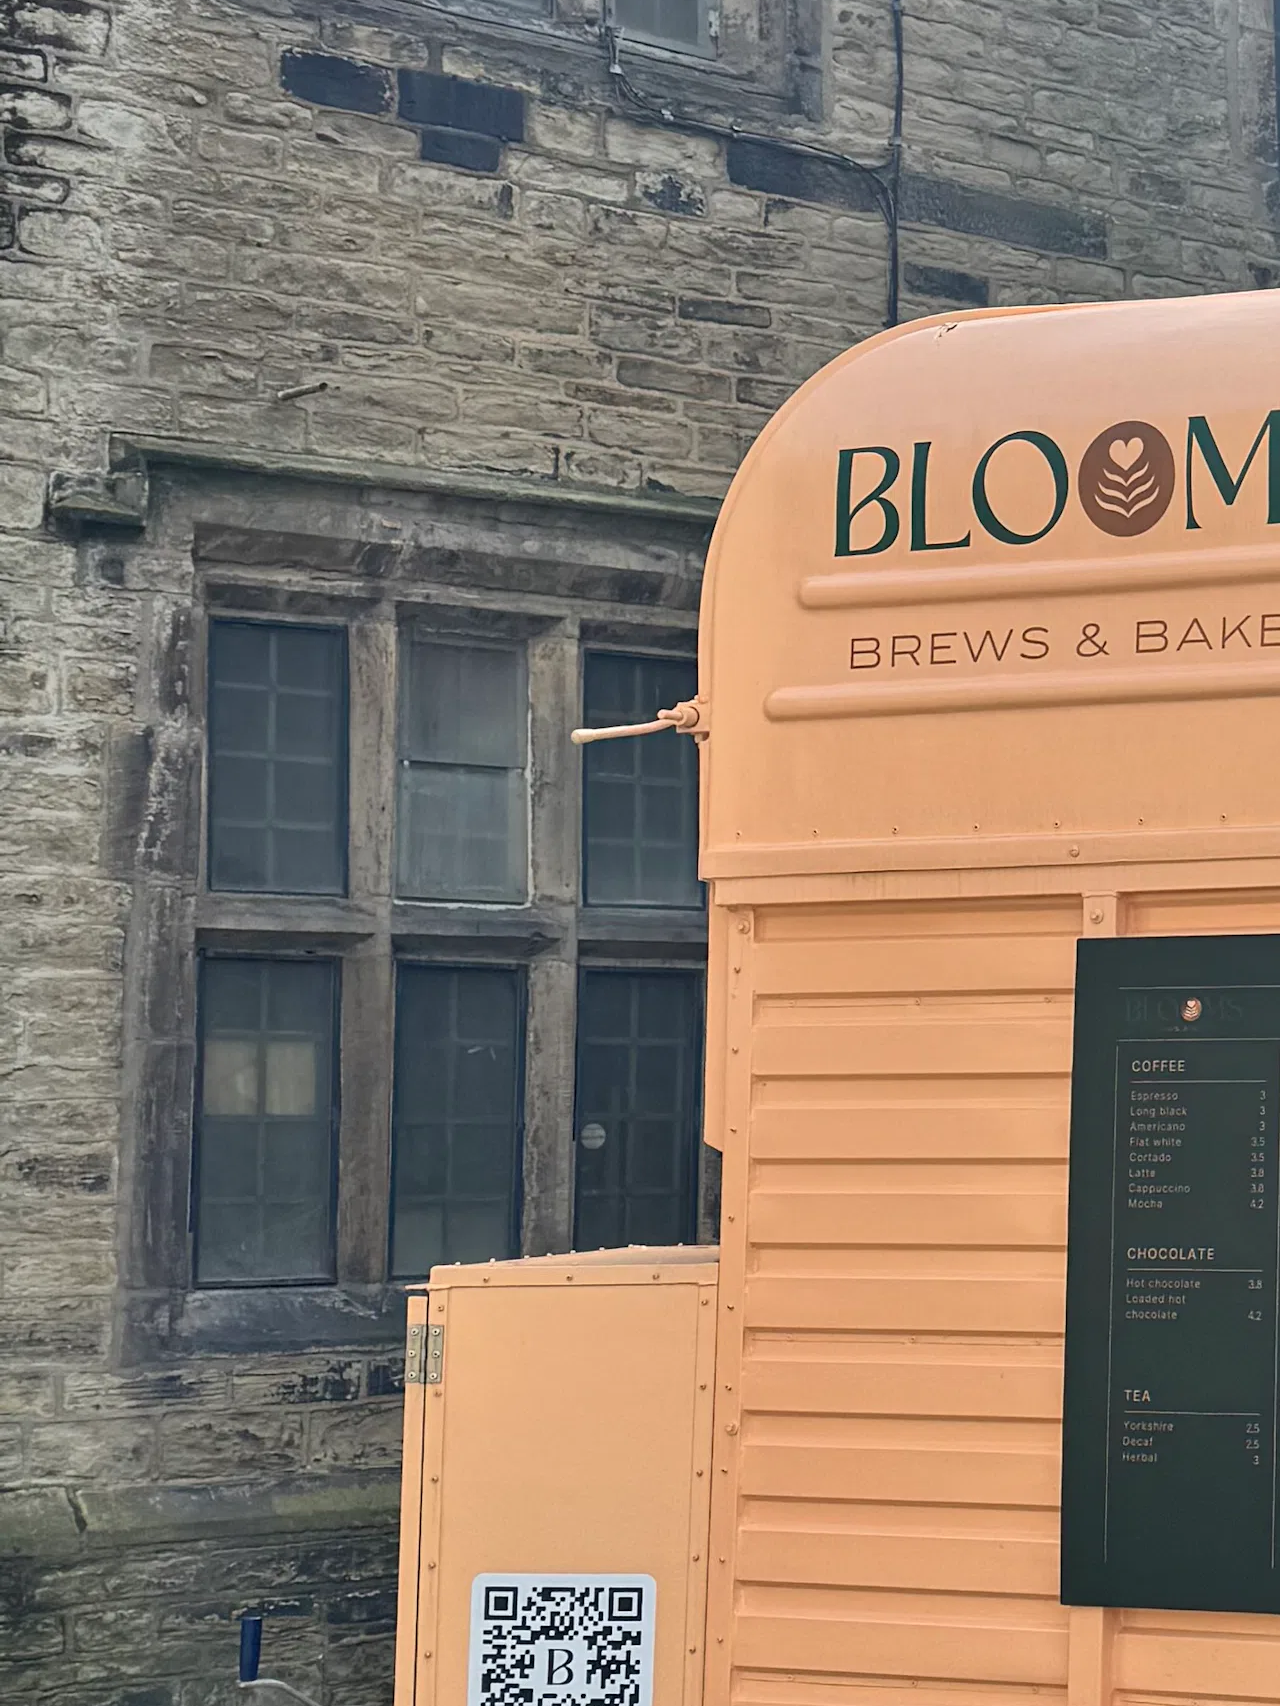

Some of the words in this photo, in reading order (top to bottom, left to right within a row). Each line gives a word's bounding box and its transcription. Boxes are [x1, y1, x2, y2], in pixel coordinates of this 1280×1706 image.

[850, 627, 1050, 670] BREWS
[1076, 623, 1110, 656] &
[1132, 1060, 1185, 1072] COFFEE
[1131, 1091, 1178, 1101] Espresso
[1260, 1090, 1265, 1100] 3
[1131, 1107, 1155, 1118] Long
[1160, 1107, 1187, 1116] black
[1260, 1106, 1265, 1115] 3
[1130, 1121, 1185, 1131] Americano
[1260, 1121, 1265, 1131] 3
[1130, 1137, 1149, 1146] Flat
[1153, 1138, 1181, 1146] white
[1251, 1137, 1265, 1146] 3.5
[1130, 1153, 1171, 1162] Cortado
[1251, 1153, 1264, 1162] 3.5
[1129, 1169, 1155, 1177] Latte
[1129, 1183, 1190, 1195] Cappuccino
[1129, 1199, 1162, 1208] Mocha
[1250, 1199, 1263, 1208] 4.2
[1127, 1248, 1214, 1259] CHOCOLATE
[1127, 1279, 1145, 1288] Hot
[1148, 1279, 1200, 1288] chocolate
[1249, 1280, 1262, 1289] 3.8
[1126, 1294, 1164, 1303] Loaded
[1169, 1295, 1185, 1304] hot
[1126, 1310, 1177, 1319] chocolate
[1248, 1311, 1261, 1320] 4.2
[1124, 1390, 1150, 1401] TEA
[1124, 1421, 1173, 1431] Yorkshire
[1246, 1423, 1260, 1433] 2.5
[1123, 1436, 1152, 1446] Decaf
[1246, 1439, 1259, 1449] 2.5
[1123, 1452, 1157, 1462] Herbal
[1253, 1455, 1259, 1465] 3
[547, 1649, 574, 1685] B
